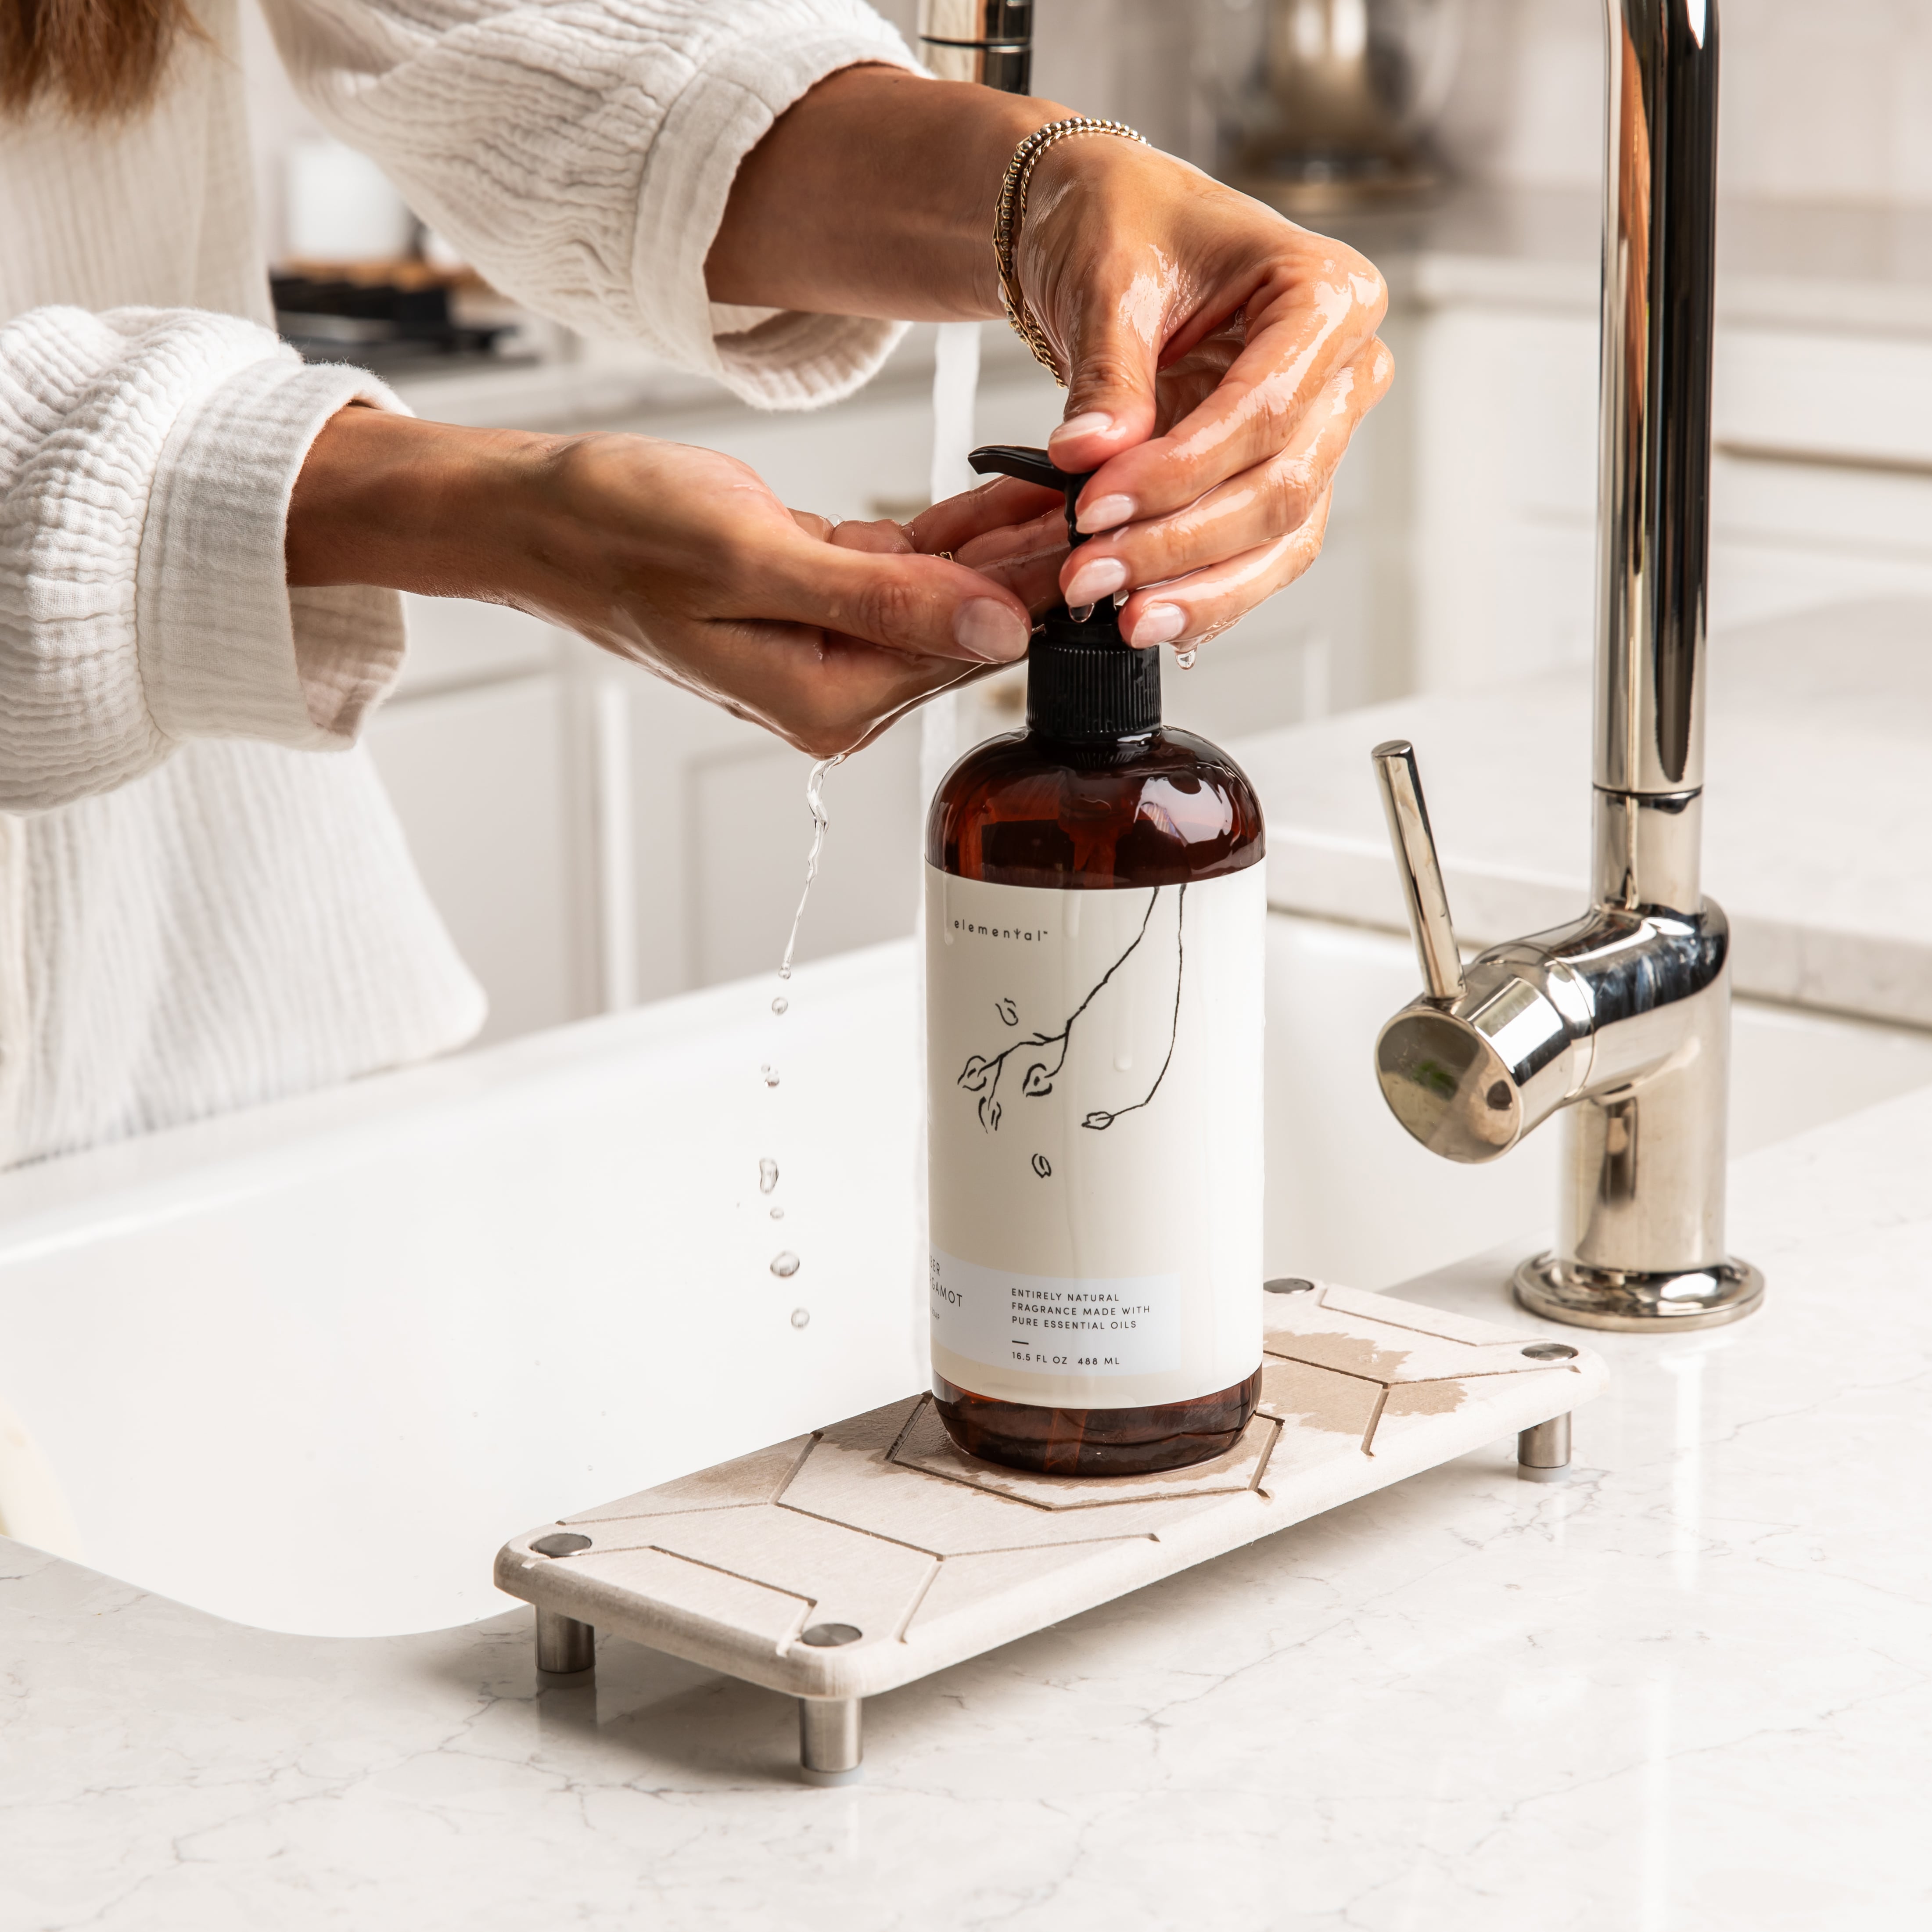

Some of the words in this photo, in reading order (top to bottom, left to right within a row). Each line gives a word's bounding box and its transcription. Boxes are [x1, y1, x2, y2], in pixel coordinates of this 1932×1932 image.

[1012, 1288, 1062, 1301] ENTIRELY
[1067, 1293, 1119, 1302] NATURAL
[1012, 1302, 1077, 1316] FRAGRANCE
[1083, 1307, 1116, 1316] MADE
[1121, 1305, 1150, 1315] WITH
[1012, 1315, 1038, 1327] PURE
[1044, 1319, 1105, 1330] ESSENTIAL
[1110, 1320, 1136, 1329] OILS
[1012, 1351, 1031, 1361] 16.5
[1036, 1354, 1048, 1363] FL
[1052, 1356, 1067, 1365] OZ
